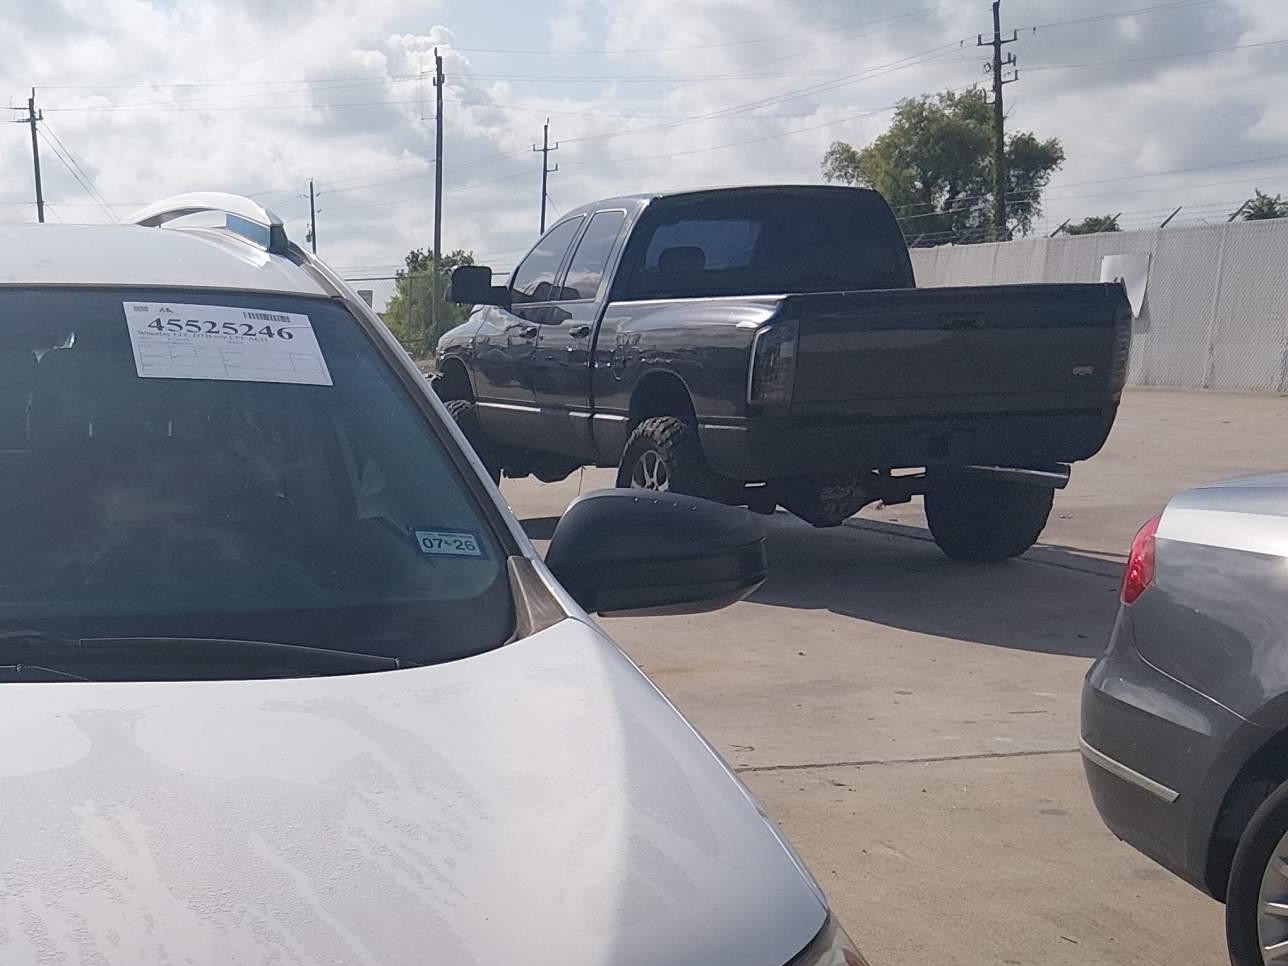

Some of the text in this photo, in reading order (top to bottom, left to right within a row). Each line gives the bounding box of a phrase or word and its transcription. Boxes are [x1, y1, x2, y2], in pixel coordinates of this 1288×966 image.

[148, 318, 294, 340] 45525246
[422, 538, 476, 551] 07 26
